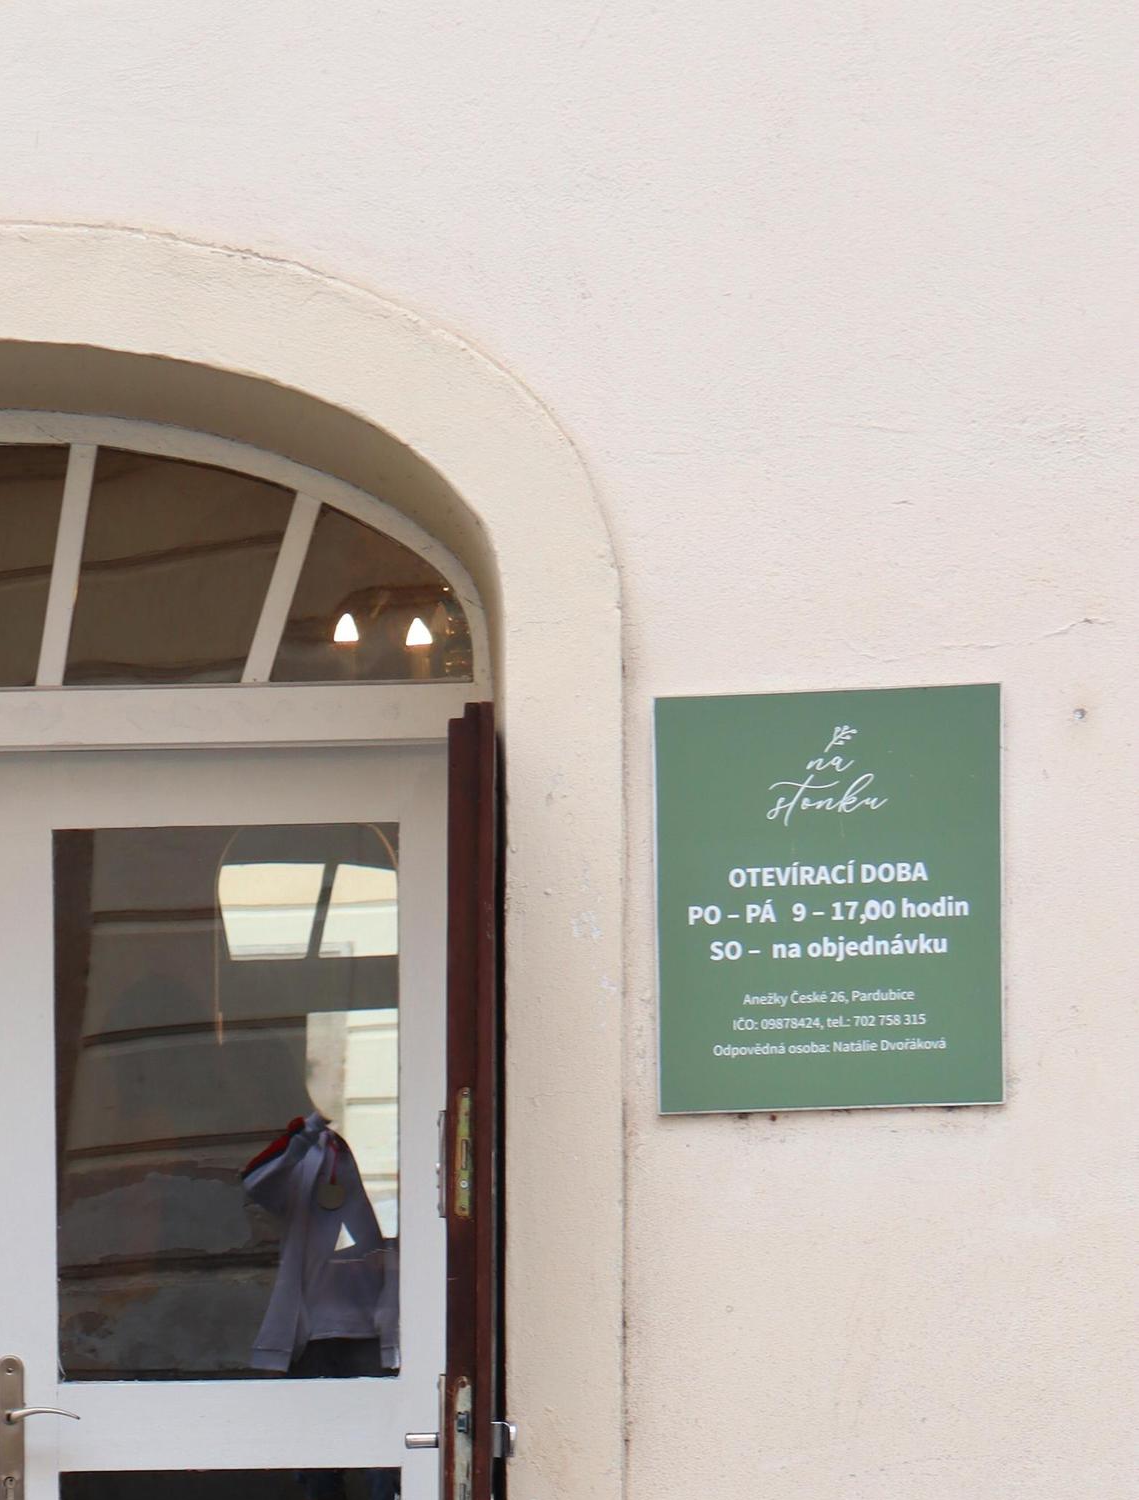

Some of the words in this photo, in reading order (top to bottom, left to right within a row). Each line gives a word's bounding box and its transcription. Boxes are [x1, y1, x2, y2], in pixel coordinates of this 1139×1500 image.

[806, 755, 854, 772] na
[766, 773, 888, 827] stonku
[728, 860, 855, 888] OTEVÍRACÍ
[860, 862, 928, 883] DOBA
[688, 905, 721, 925] PO
[746, 899, 777, 923] PÁ
[792, 903, 806, 922] 9
[831, 899, 896, 924] 17,00
[901, 896, 969, 918] hodin
[710, 941, 742, 961] SO
[772, 942, 801, 959] na
[807, 933, 948, 961] objednávku
[743, 993, 788, 1007] Anežky
[790, 990, 828, 1004] České
[829, 990, 849, 1004] 26,
[851, 988, 915, 1002] Pardubice
[732, 1017, 759, 1031] IČO:
[761, 1017, 824, 1030] 09878424,
[827, 1015, 851, 1028] tel.:
[853, 1015, 876, 1027] 702
[878, 1014, 901, 1026] 758
[903, 1013, 926, 1025] 315
[713, 1042, 786, 1058] Odpovědná
[788, 1041, 830, 1054] osoba:
[833, 1039, 878, 1052] Natálie
[880, 1037, 947, 1051] Dvořáková
